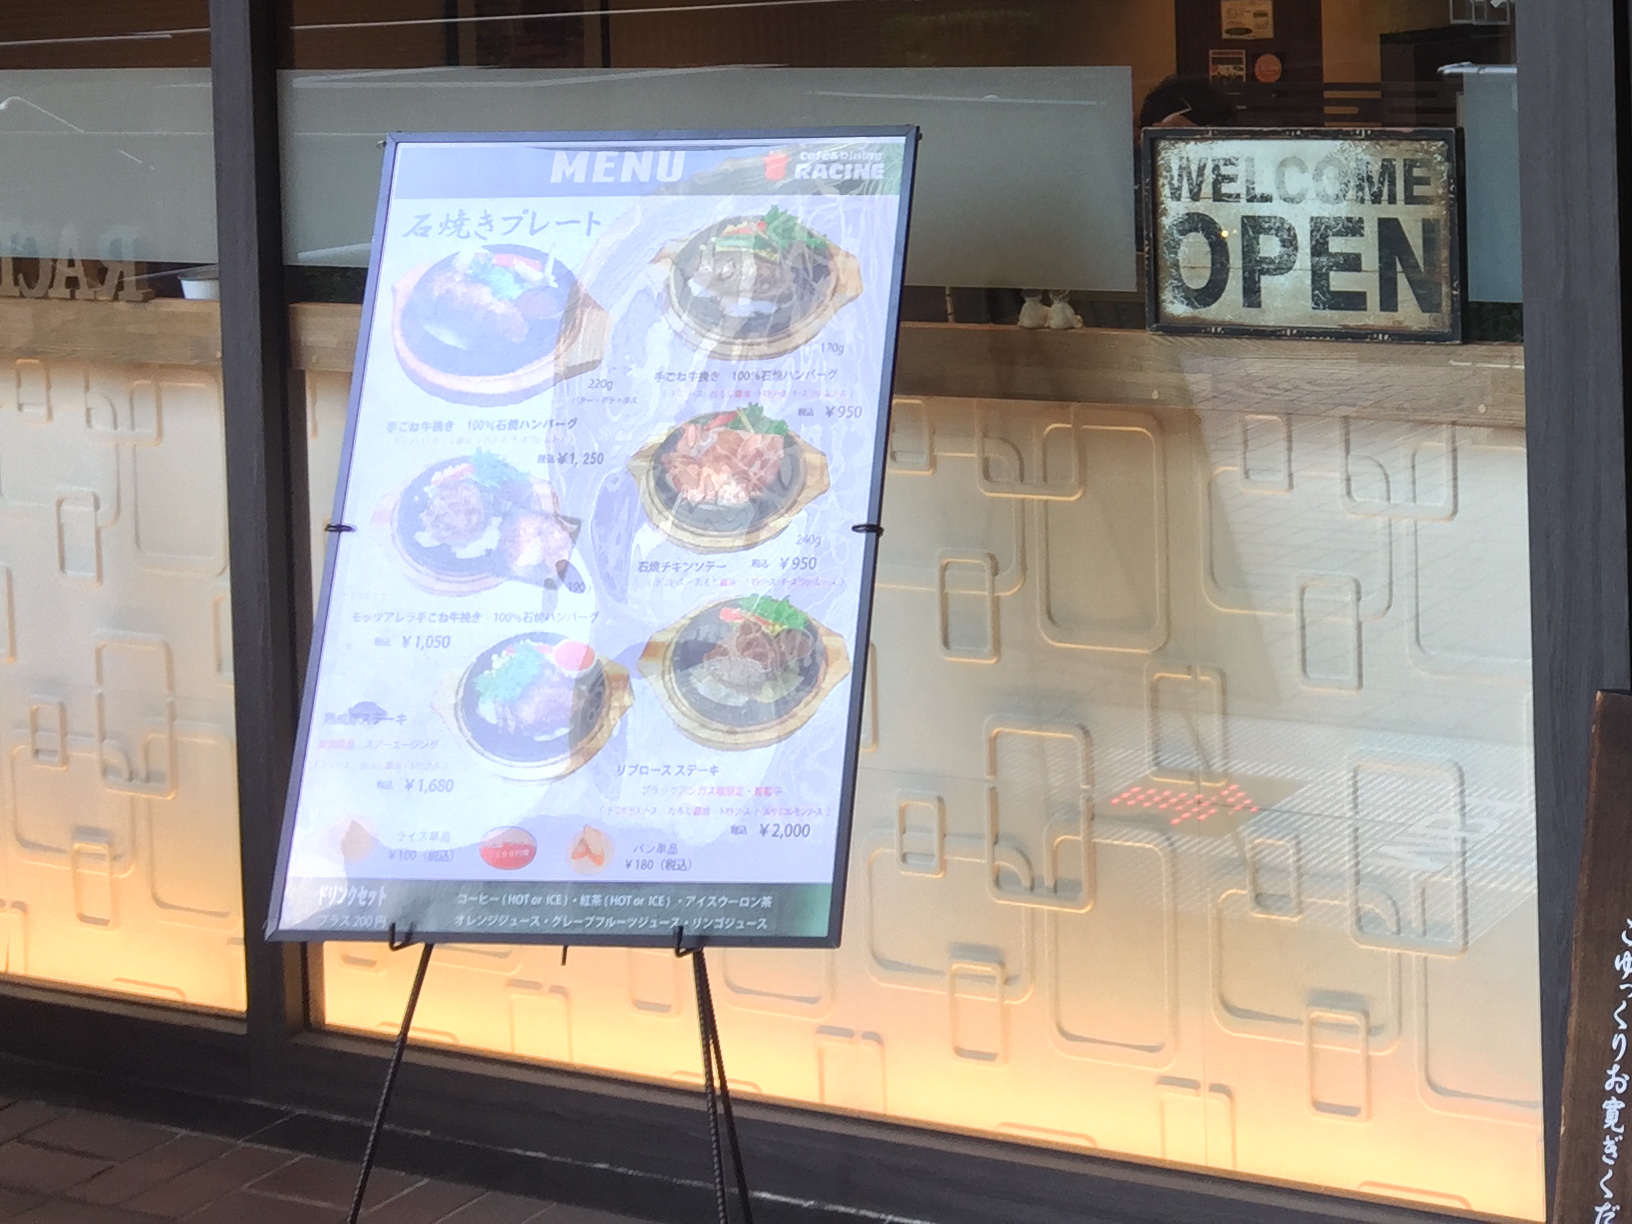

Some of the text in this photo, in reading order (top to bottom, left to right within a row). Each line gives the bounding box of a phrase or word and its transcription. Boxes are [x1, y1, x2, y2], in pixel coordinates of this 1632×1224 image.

[550, 150, 686, 184] MENU
[794, 162, 885, 181] RACINE
[1160, 155, 1436, 206] WELCOME
[402, 209, 602, 240] 石焼きプレート
[1165, 212, 1442, 314] OPEN
[587, 378, 614, 391] 220g
[632, 842, 679, 856] パン単品
